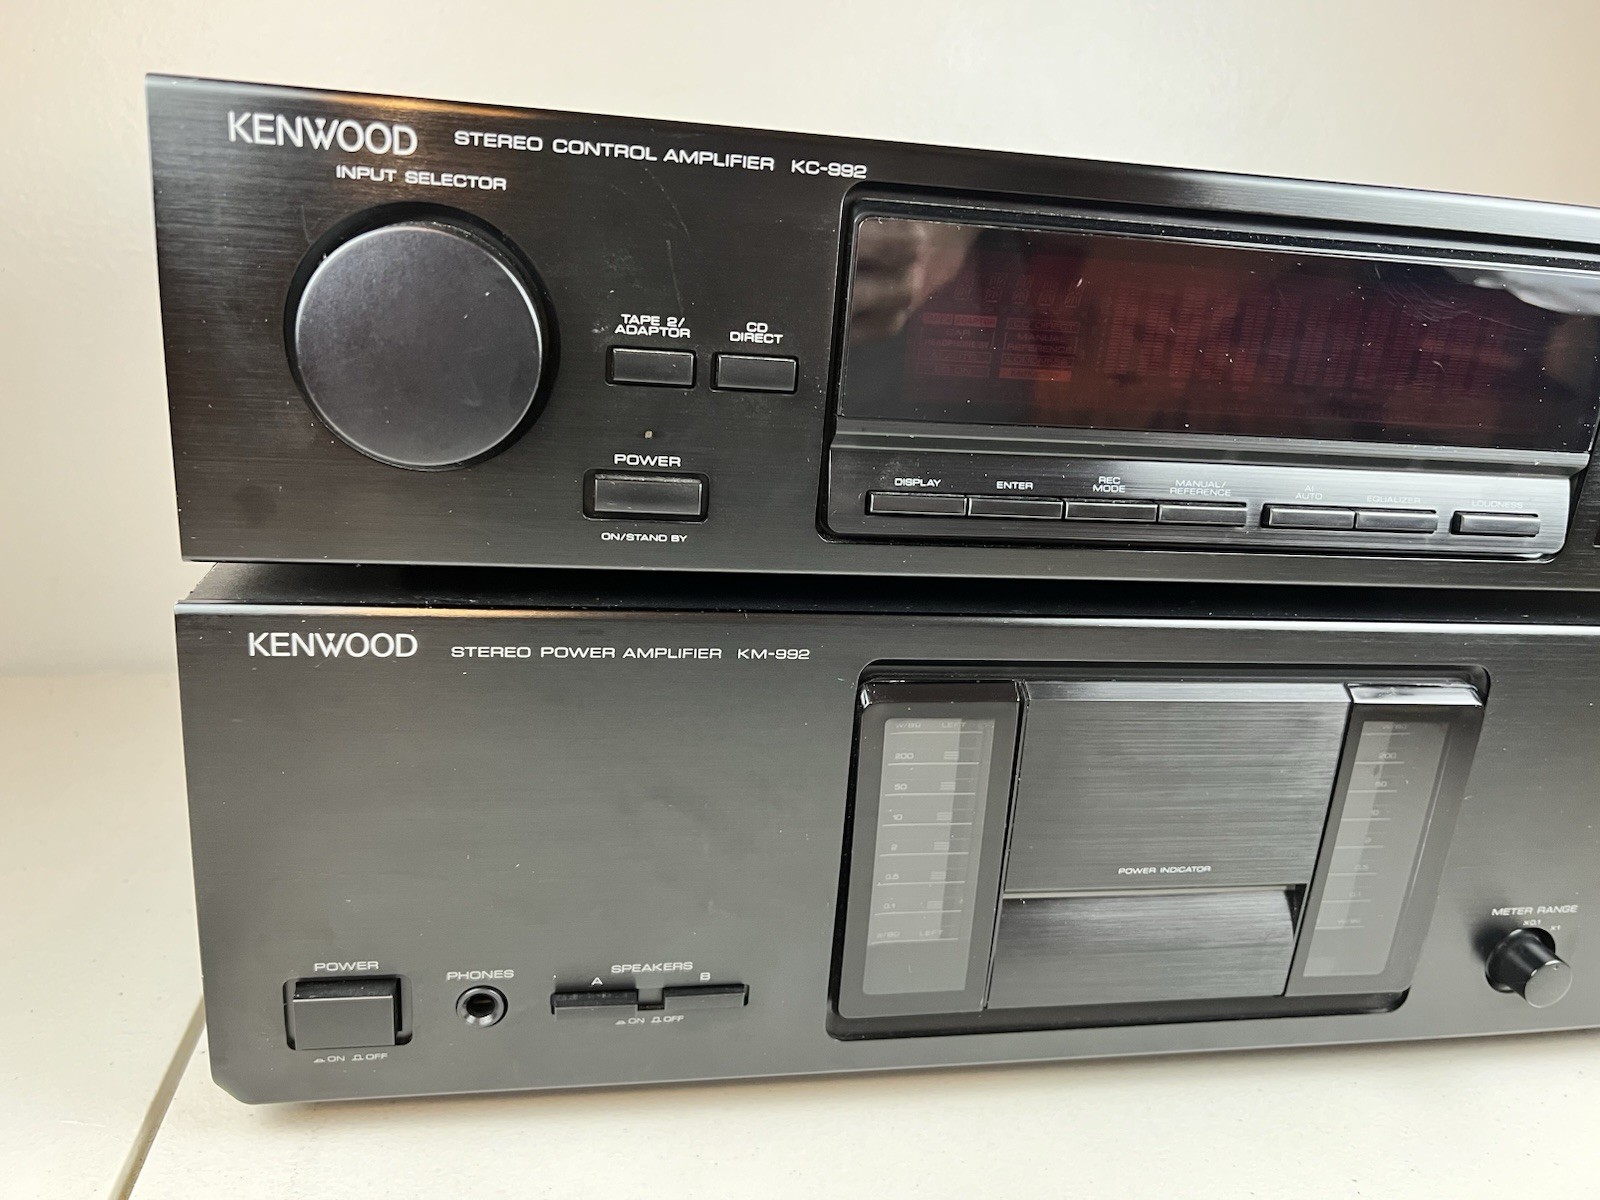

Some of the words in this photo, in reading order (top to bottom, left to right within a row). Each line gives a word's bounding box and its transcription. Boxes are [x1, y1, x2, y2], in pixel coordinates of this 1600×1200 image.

[227, 110, 418, 156] KENWOOD
[454, 130, 544, 152] STEREO
[552, 138, 658, 162] CONTROL
[663, 148, 774, 171] AMPLIFIER
[791, 159, 868, 179] KC-992
[336, 164, 397, 182] INPUT
[404, 170, 507, 190] SELECTOR
[621, 314, 660, 327] TAPE
[666, 317, 686, 328] 2/
[614, 324, 691, 338] ADAPTOR
[746, 322, 768, 333] CD
[730, 332, 784, 344] DIRECT
[614, 454, 682, 468] POWER
[894, 477, 942, 488] DISPLAY
[996, 480, 1034, 490] ENTER
[1098, 476, 1120, 486] REC
[1175, 479, 1227, 490] MANUAL/
[1092, 484, 1126, 494] MODE
[1170, 486, 1232, 497] REFERENCE
[1295, 492, 1323, 500] AUTO
[1366, 495, 1421, 505] EQUALIZER
[1471, 500, 1524, 510] LOUDNESS
[601, 532, 668, 542] ON/STAND
[670, 534, 688, 543] BY
[248, 632, 418, 660] KENWOOD
[450, 646, 532, 660] STEREO
[540, 646, 616, 660] POWER
[622, 646, 722, 660] AMPLIFIER
[736, 648, 811, 660] KM-992
[894, 782, 908, 790] 50
[1118, 866, 1156, 875] POWER
[1160, 866, 1212, 874] INDICATOR
[1492, 906, 1534, 916] METER
[1536, 904, 1579, 914] RANGE
[314, 960, 380, 972] POWER
[610, 961, 694, 974] SPEAKERS
[446, 969, 515, 981] PHONES
[700, 972, 711, 981] B
[591, 976, 604, 986] A
[663, 1014, 685, 1023] OFF
[366, 1052, 389, 1062] OFF
